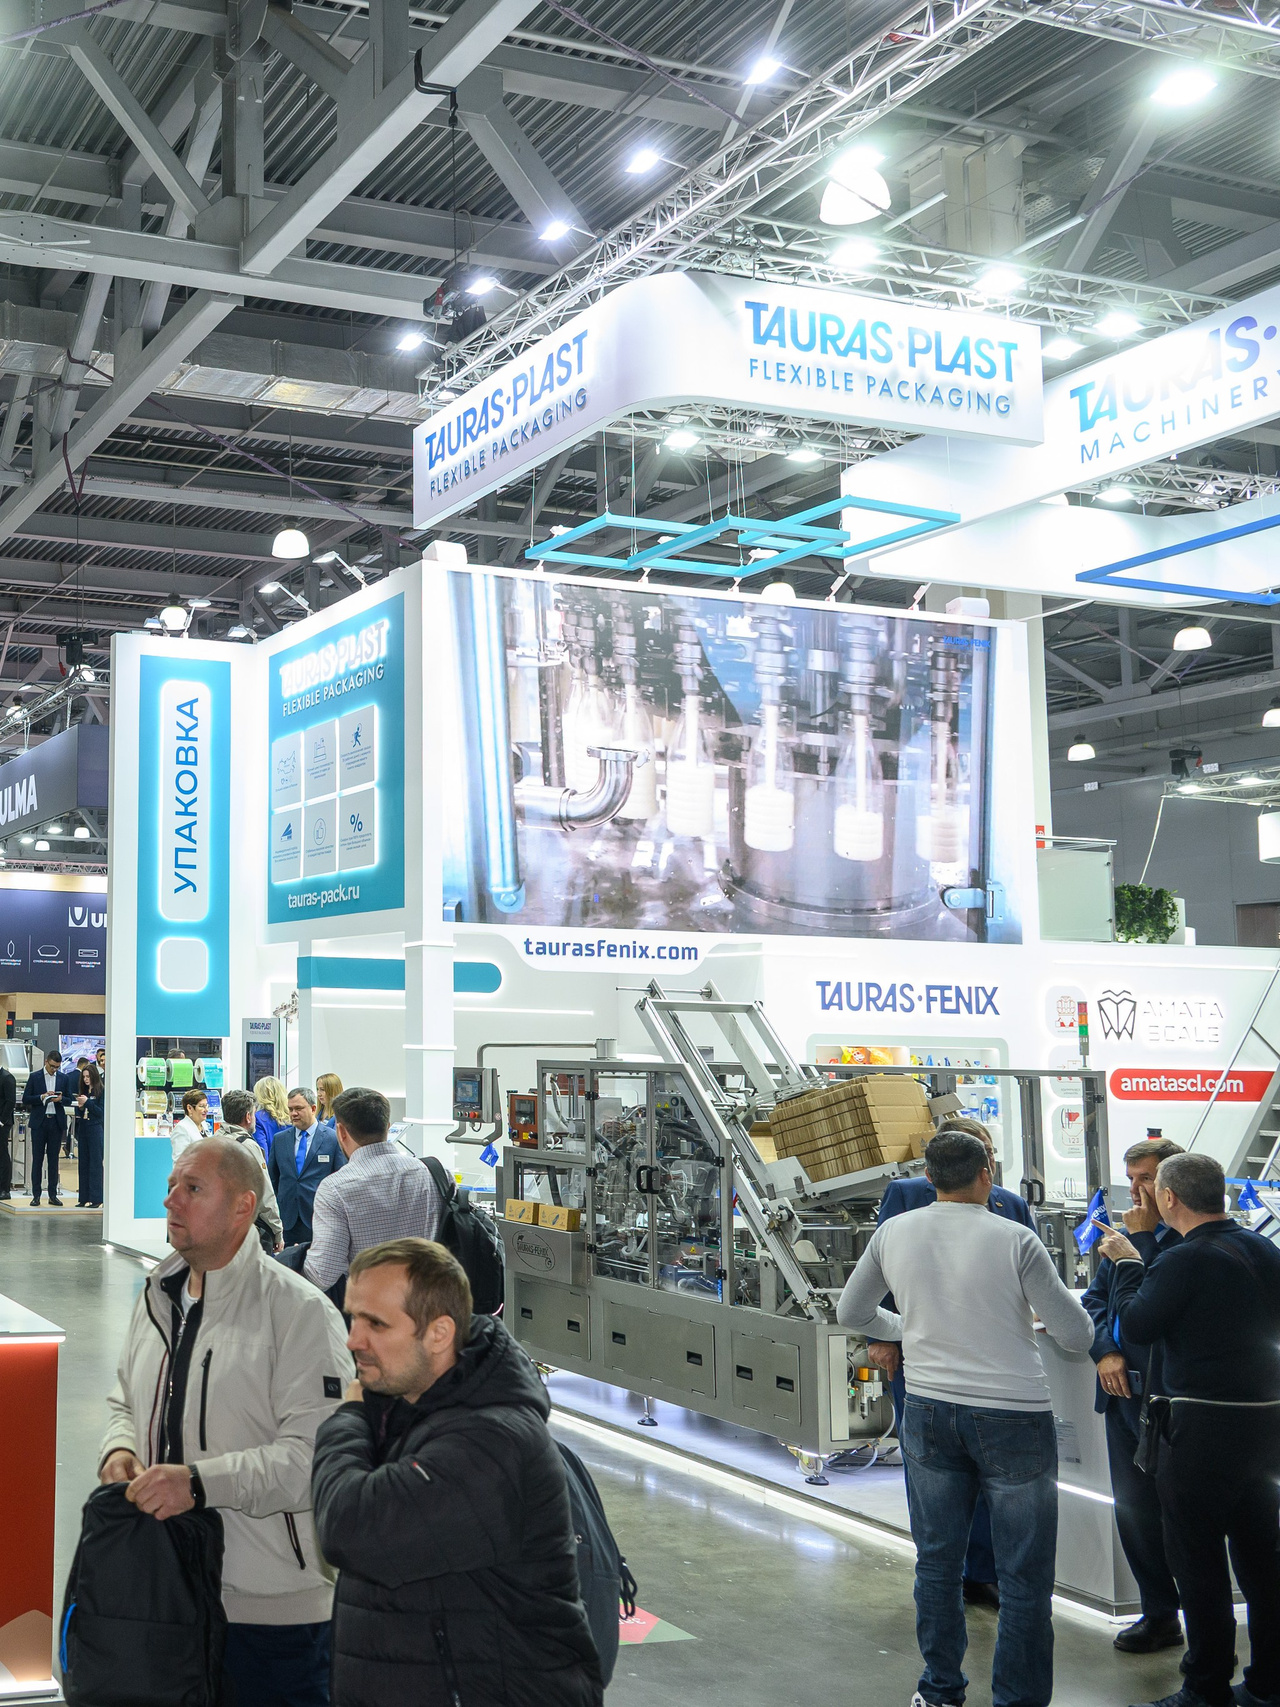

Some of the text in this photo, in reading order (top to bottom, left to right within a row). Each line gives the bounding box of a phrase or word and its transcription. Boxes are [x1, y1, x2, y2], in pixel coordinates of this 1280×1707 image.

[749, 358, 1011, 415] FLEXIBLE PACKAGING
[430, 387, 588, 500] FLEXIBLE PACKAGING
[1080, 370, 1280, 464] MACHINER
[282, 663, 385, 717] FLEXIBLE PACKAGING
[0, 774, 38, 826] ULMA
[174, 698, 199, 894] УПАКОВКА
[288, 884, 360, 909] tauras-pack.ru
[524, 937, 698, 960] taurasfenix.com
[1149, 1025, 1220, 1043] SCALE
[1120, 1074, 1244, 1093] amatascl.com
